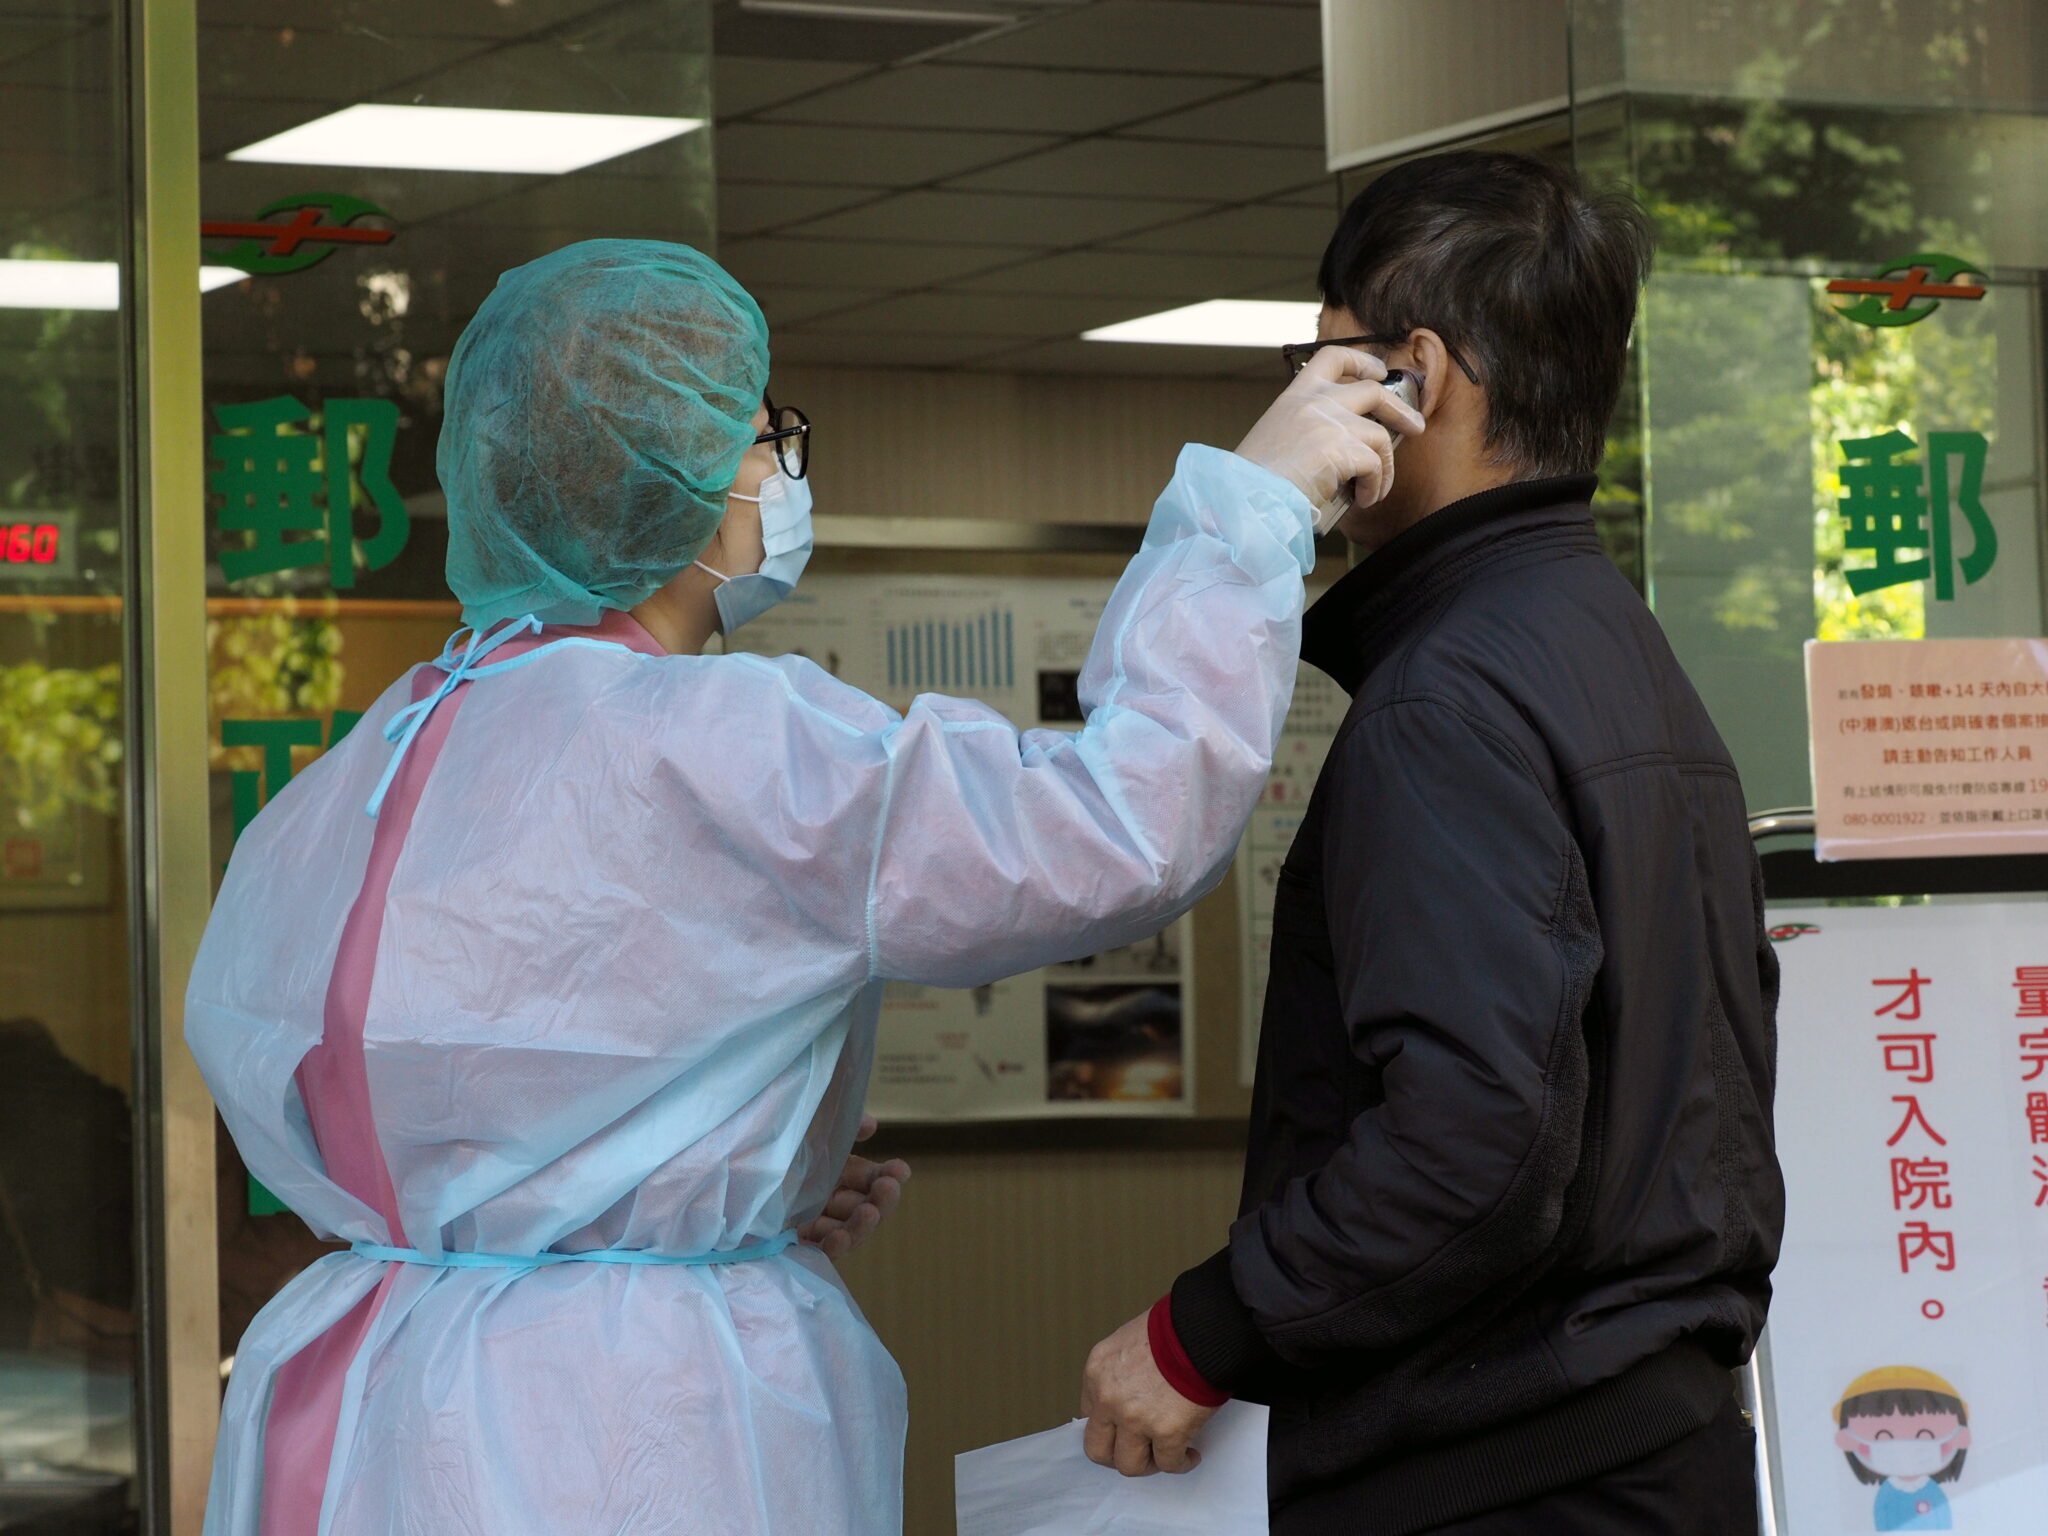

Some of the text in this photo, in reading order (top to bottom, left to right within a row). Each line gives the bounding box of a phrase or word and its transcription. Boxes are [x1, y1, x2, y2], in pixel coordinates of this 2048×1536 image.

[1883, 746, 2033, 764] 請主動告知工作人員
[1871, 968, 1956, 1321] 才可入院內。
